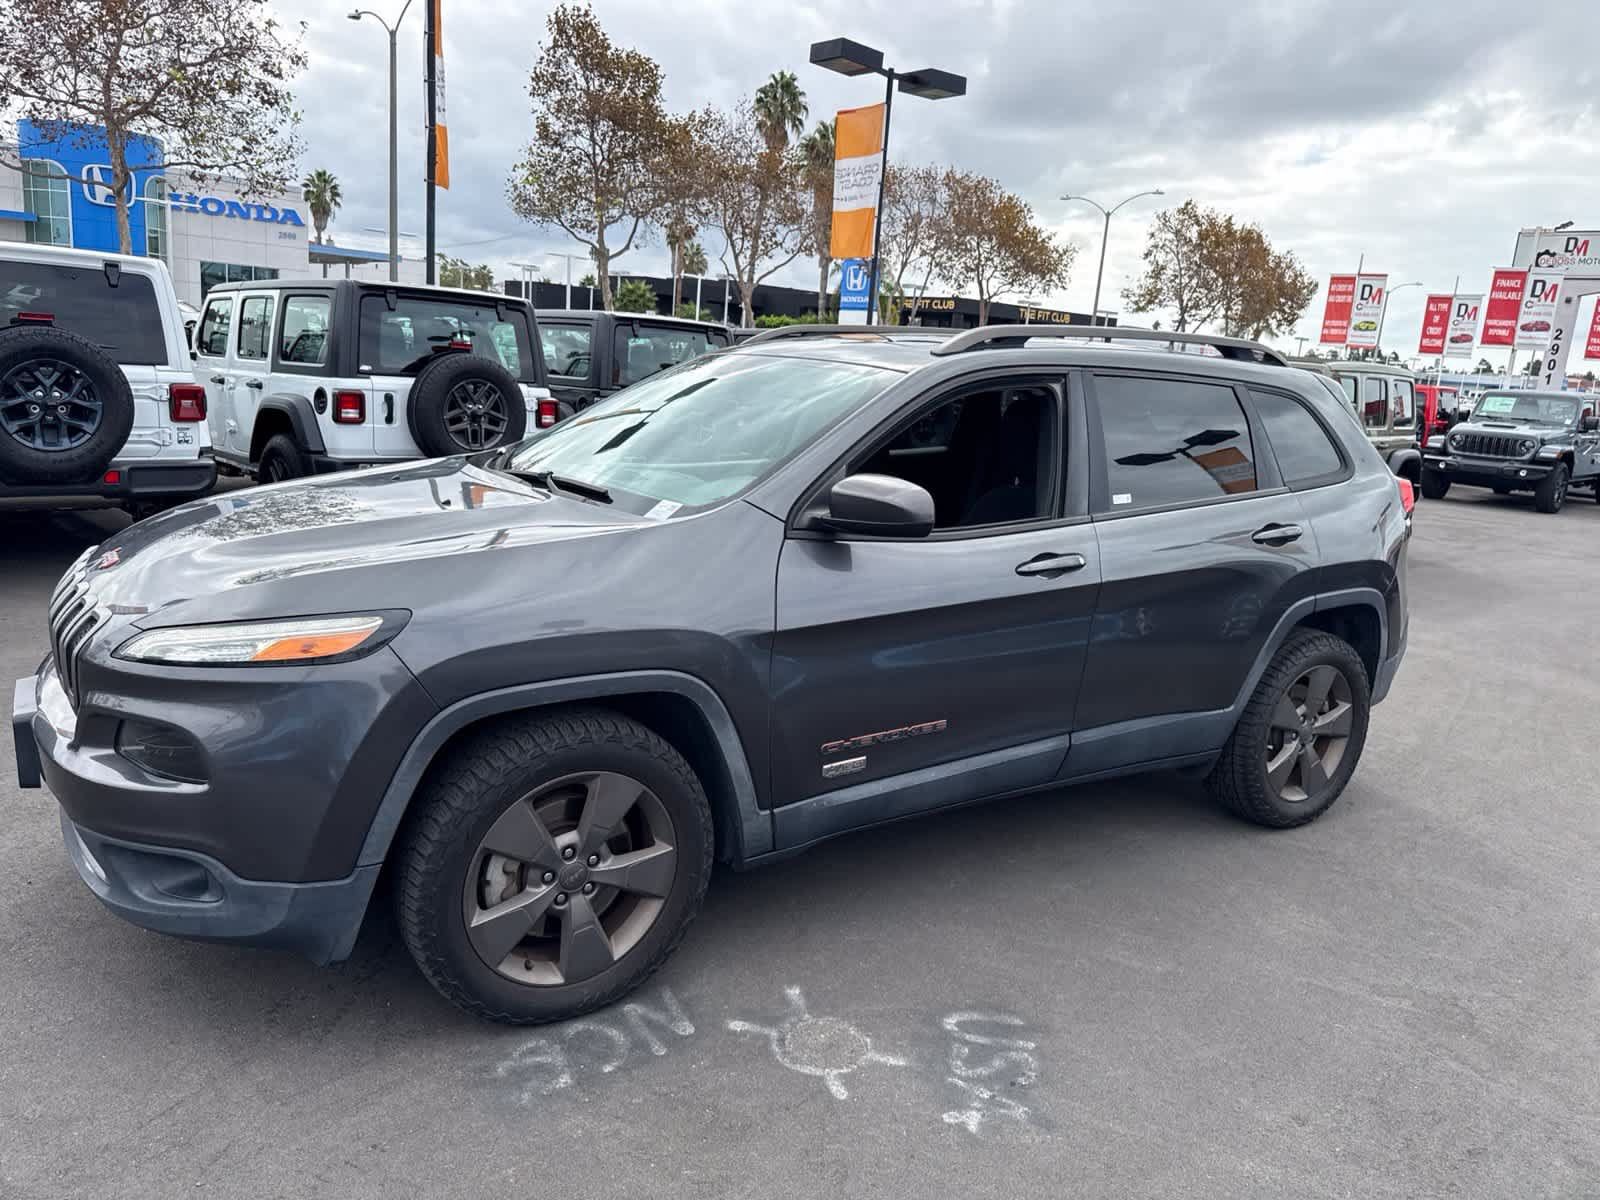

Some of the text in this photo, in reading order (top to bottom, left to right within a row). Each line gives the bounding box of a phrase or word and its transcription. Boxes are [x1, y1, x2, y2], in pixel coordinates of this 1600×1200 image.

[168, 192, 306, 227] HONDA
[1564, 237, 1590, 256] DM
[1496, 279, 1521, 288] FINANCE
[1530, 279, 1559, 303] DM
[841, 295, 869, 303] HONDA
[1360, 283, 1384, 305] DM
[1491, 290, 1522, 301] AVAILABLE
[932, 299, 955, 310] CLUB
[1456, 303, 1479, 321] DM
[1019, 308, 1071, 324] THE FIT CLUB
[1544, 328, 1564, 386] 2901
